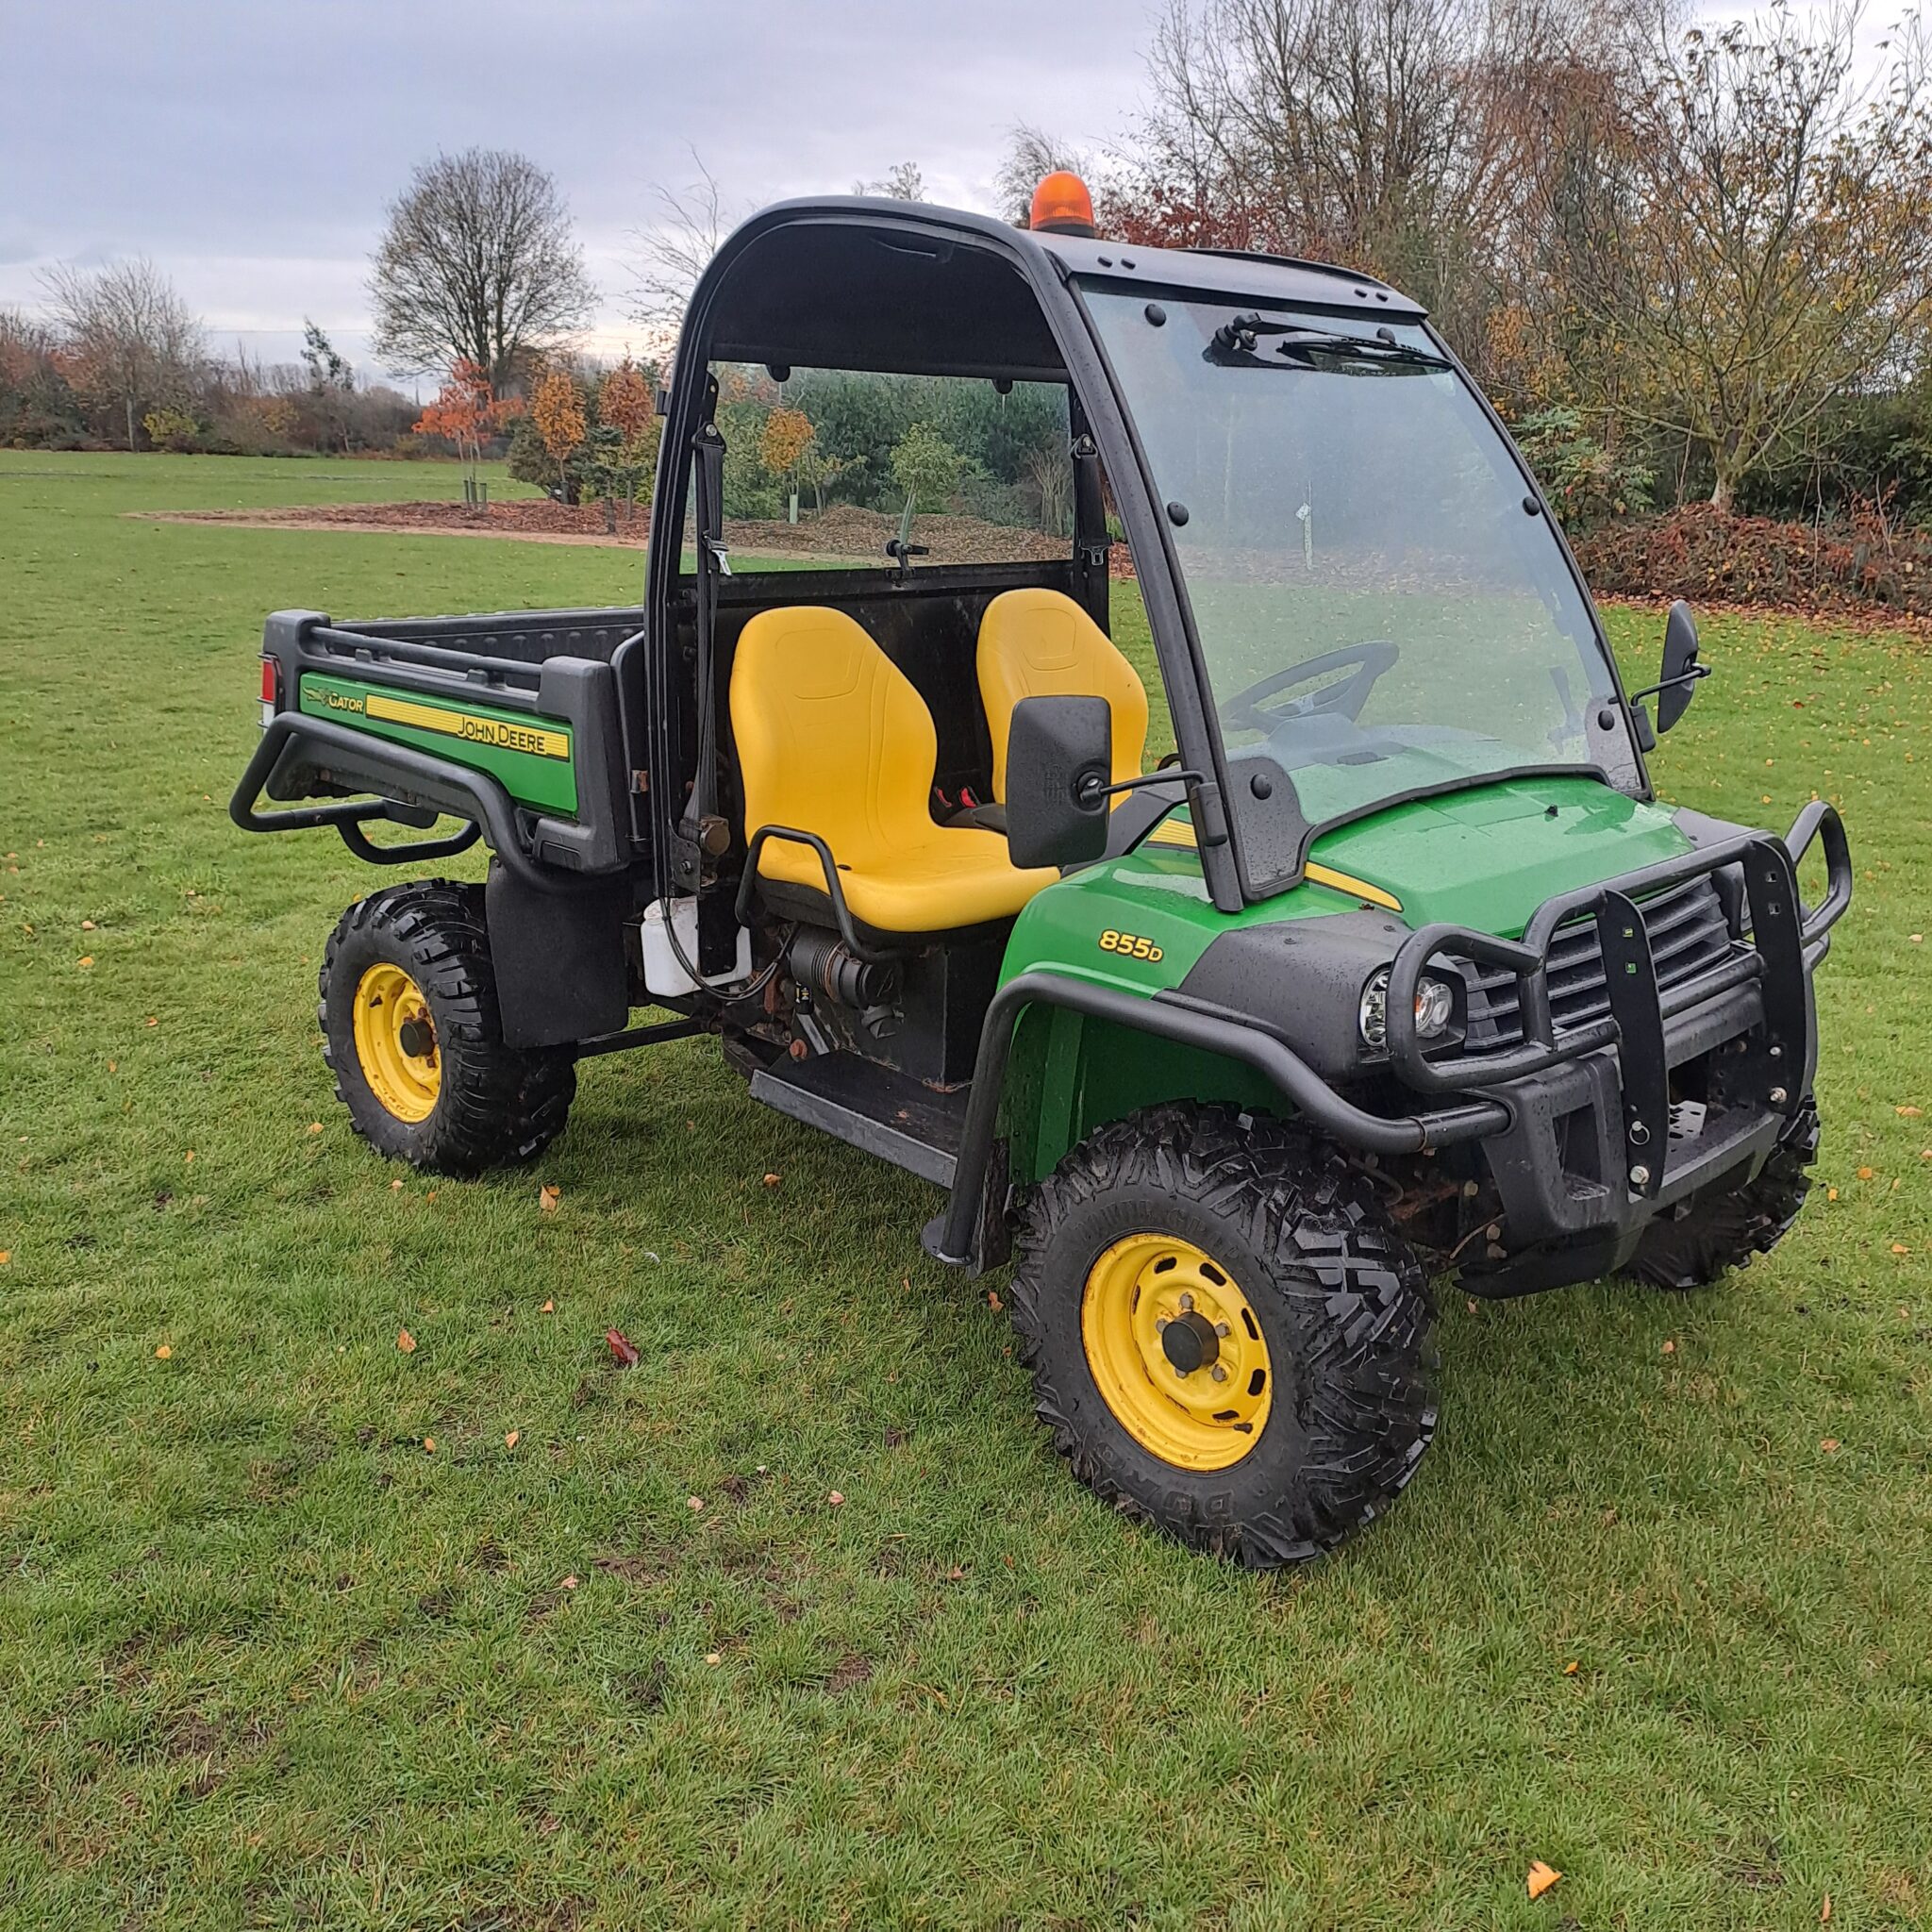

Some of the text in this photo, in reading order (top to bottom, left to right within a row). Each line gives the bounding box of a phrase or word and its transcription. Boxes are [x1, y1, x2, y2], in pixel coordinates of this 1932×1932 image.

[328, 692, 364, 713] GATOR
[458, 716, 545, 753] JOHN DEERE
[1098, 929, 1164, 963] 855D
[1094, 1441, 1235, 1517] DURO
